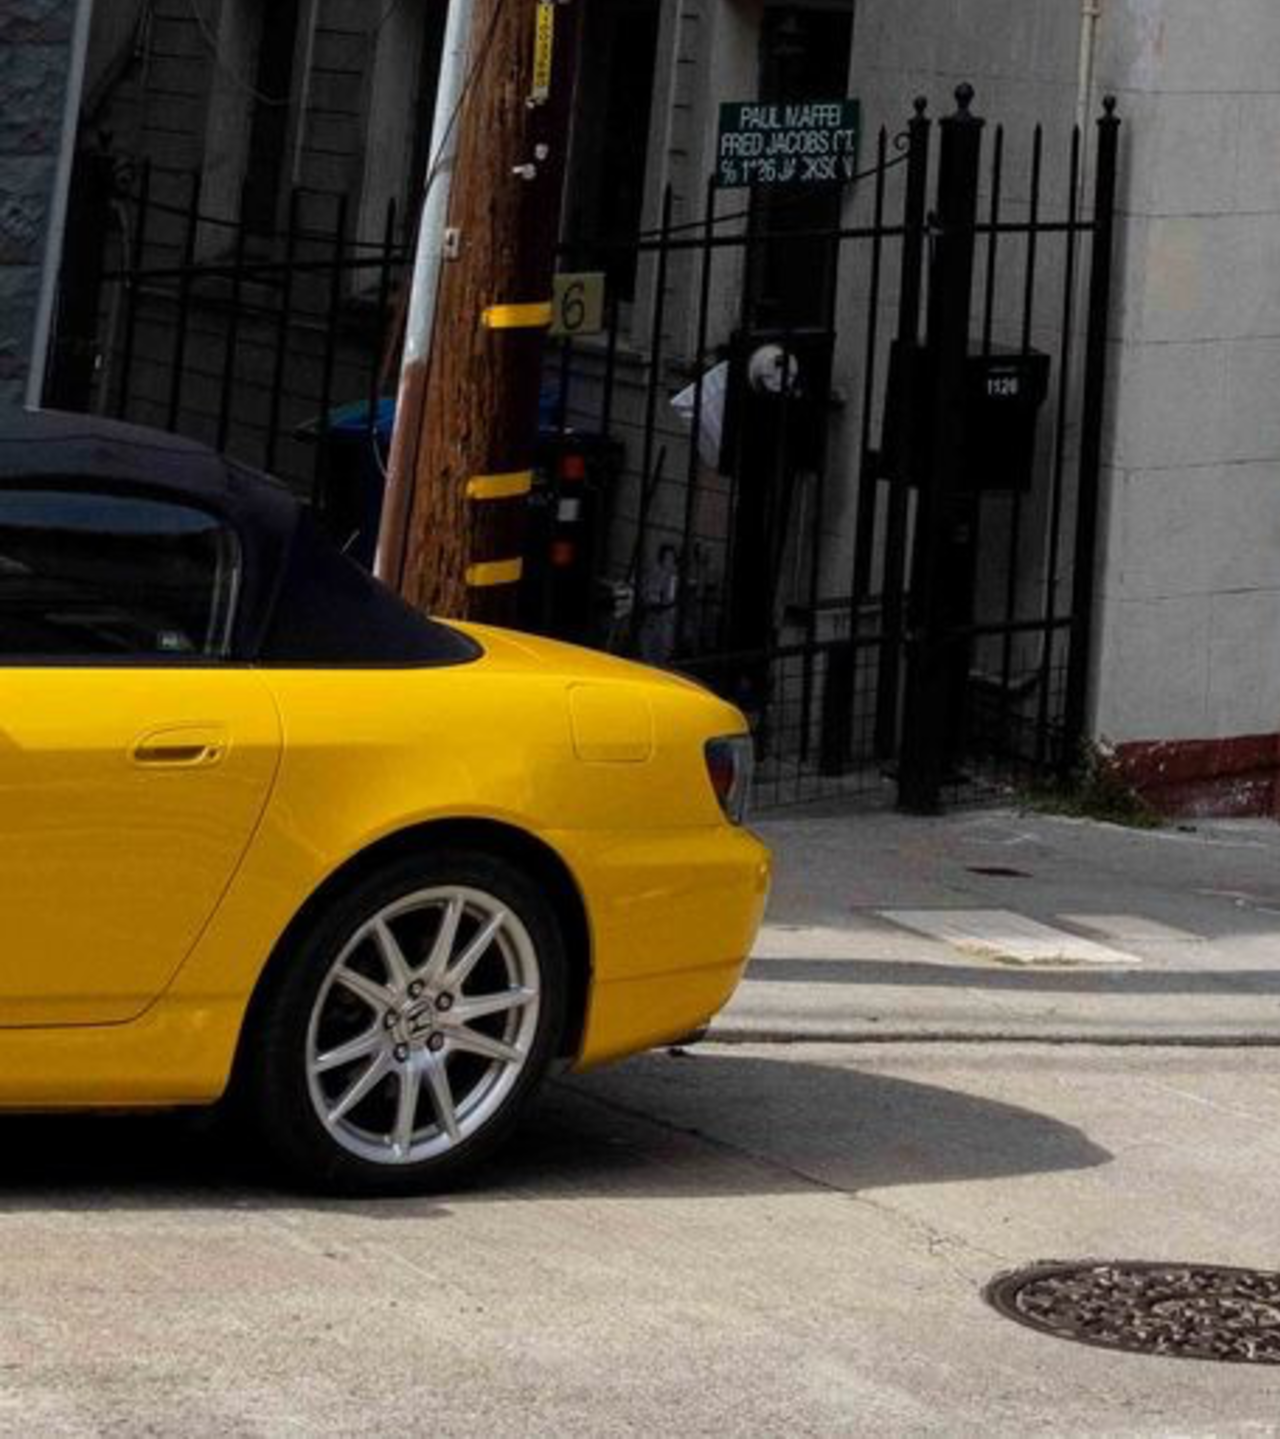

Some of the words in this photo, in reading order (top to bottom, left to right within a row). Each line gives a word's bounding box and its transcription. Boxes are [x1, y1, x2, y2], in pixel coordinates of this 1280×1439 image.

[739, 106, 782, 129] PAUL
[720, 132, 763, 157] FRED
[766, 130, 830, 155] JACOBS
[561, 280, 585, 331] 6
